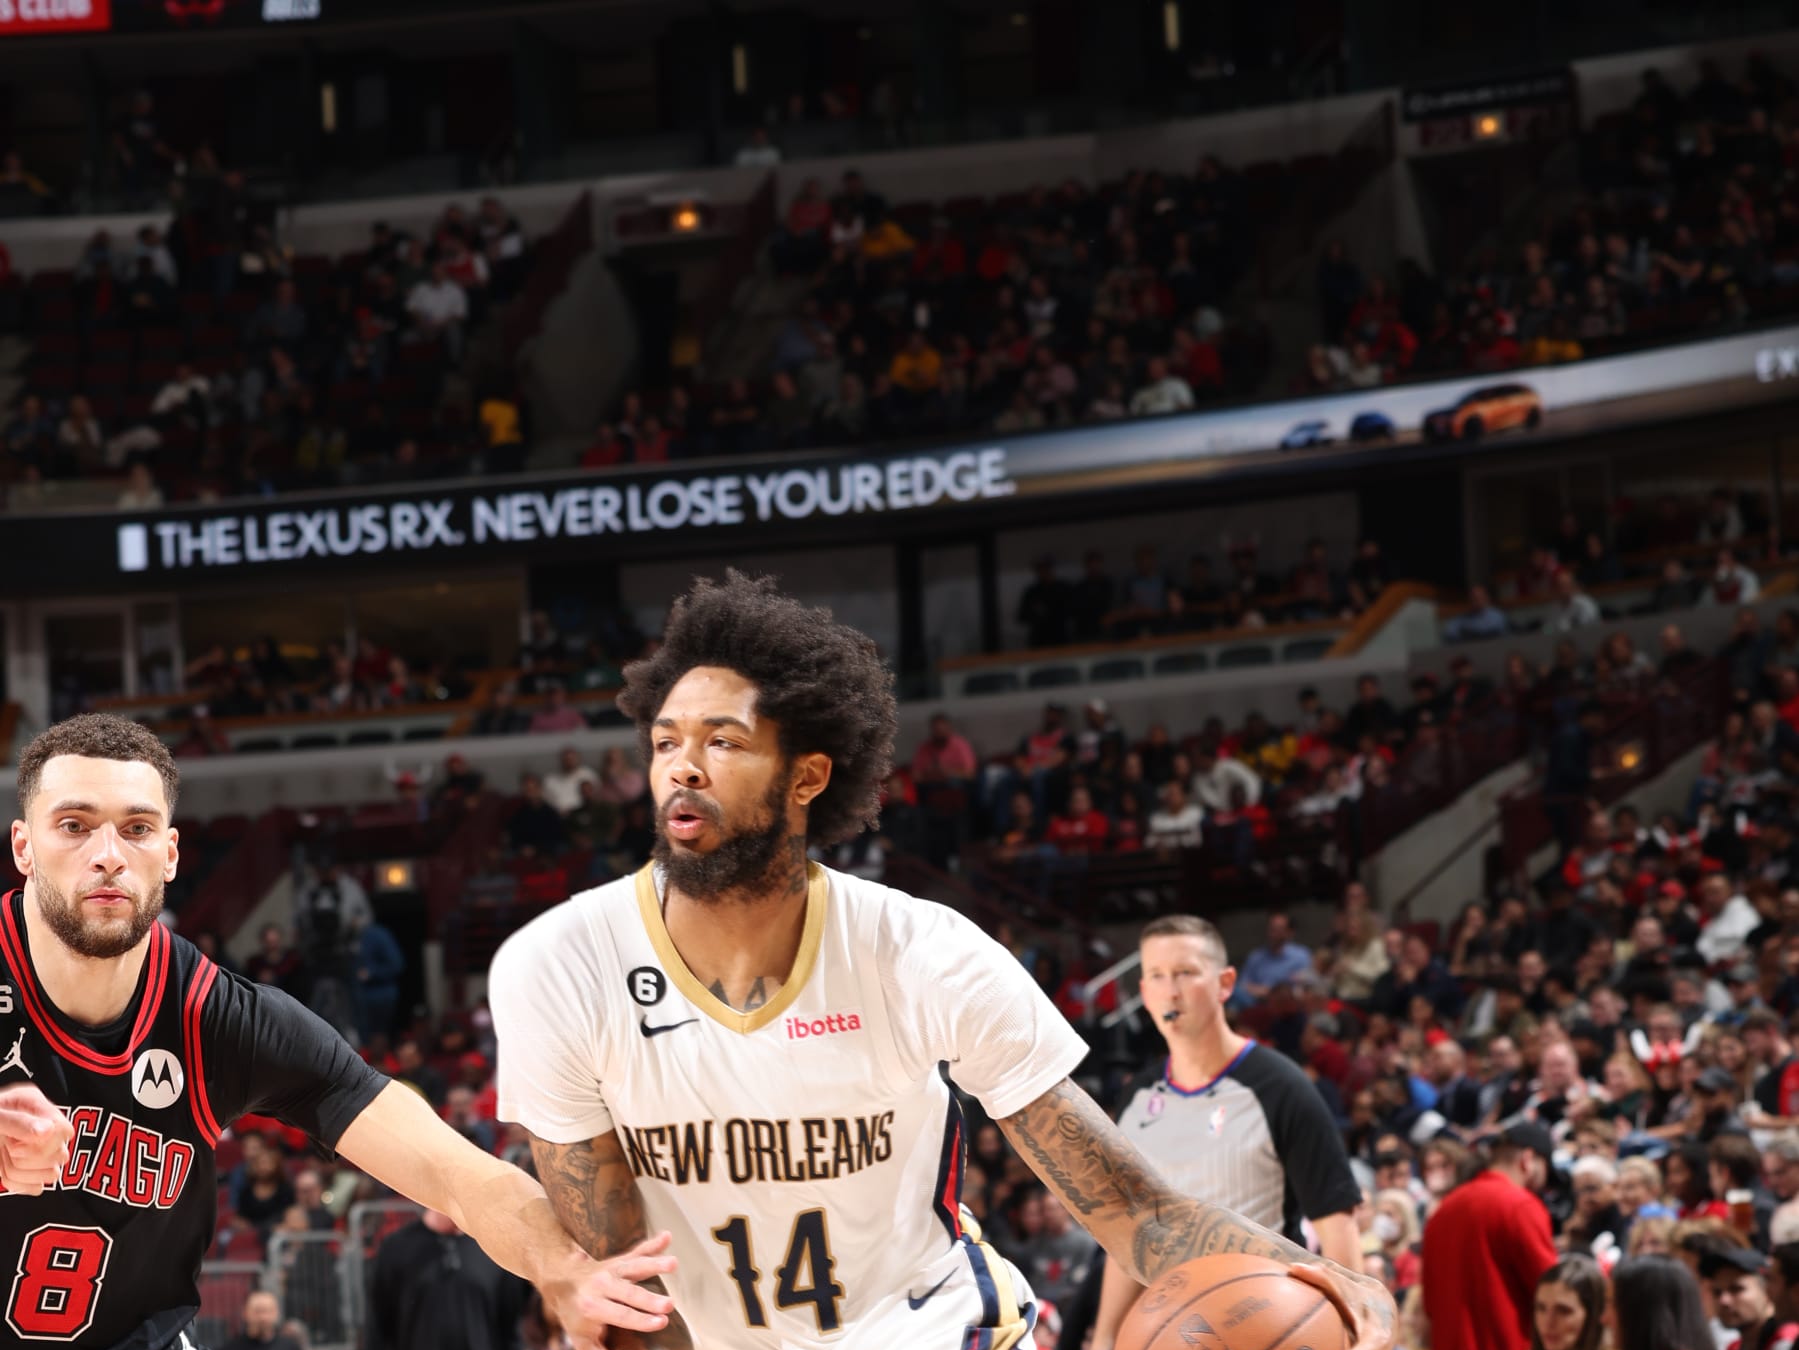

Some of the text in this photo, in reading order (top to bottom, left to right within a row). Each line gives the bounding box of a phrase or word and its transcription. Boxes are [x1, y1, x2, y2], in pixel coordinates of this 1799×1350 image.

[156, 448, 1016, 568] THE LEXUS RX. NEVER LOSE YOUR EDGE.
[633, 971, 659, 1003] 6
[786, 1011, 861, 1039] ibotta
[621, 1110, 895, 1185] NEW ORLEANS
[5, 1223, 113, 1341] 8
[710, 1206, 846, 1335] 14
